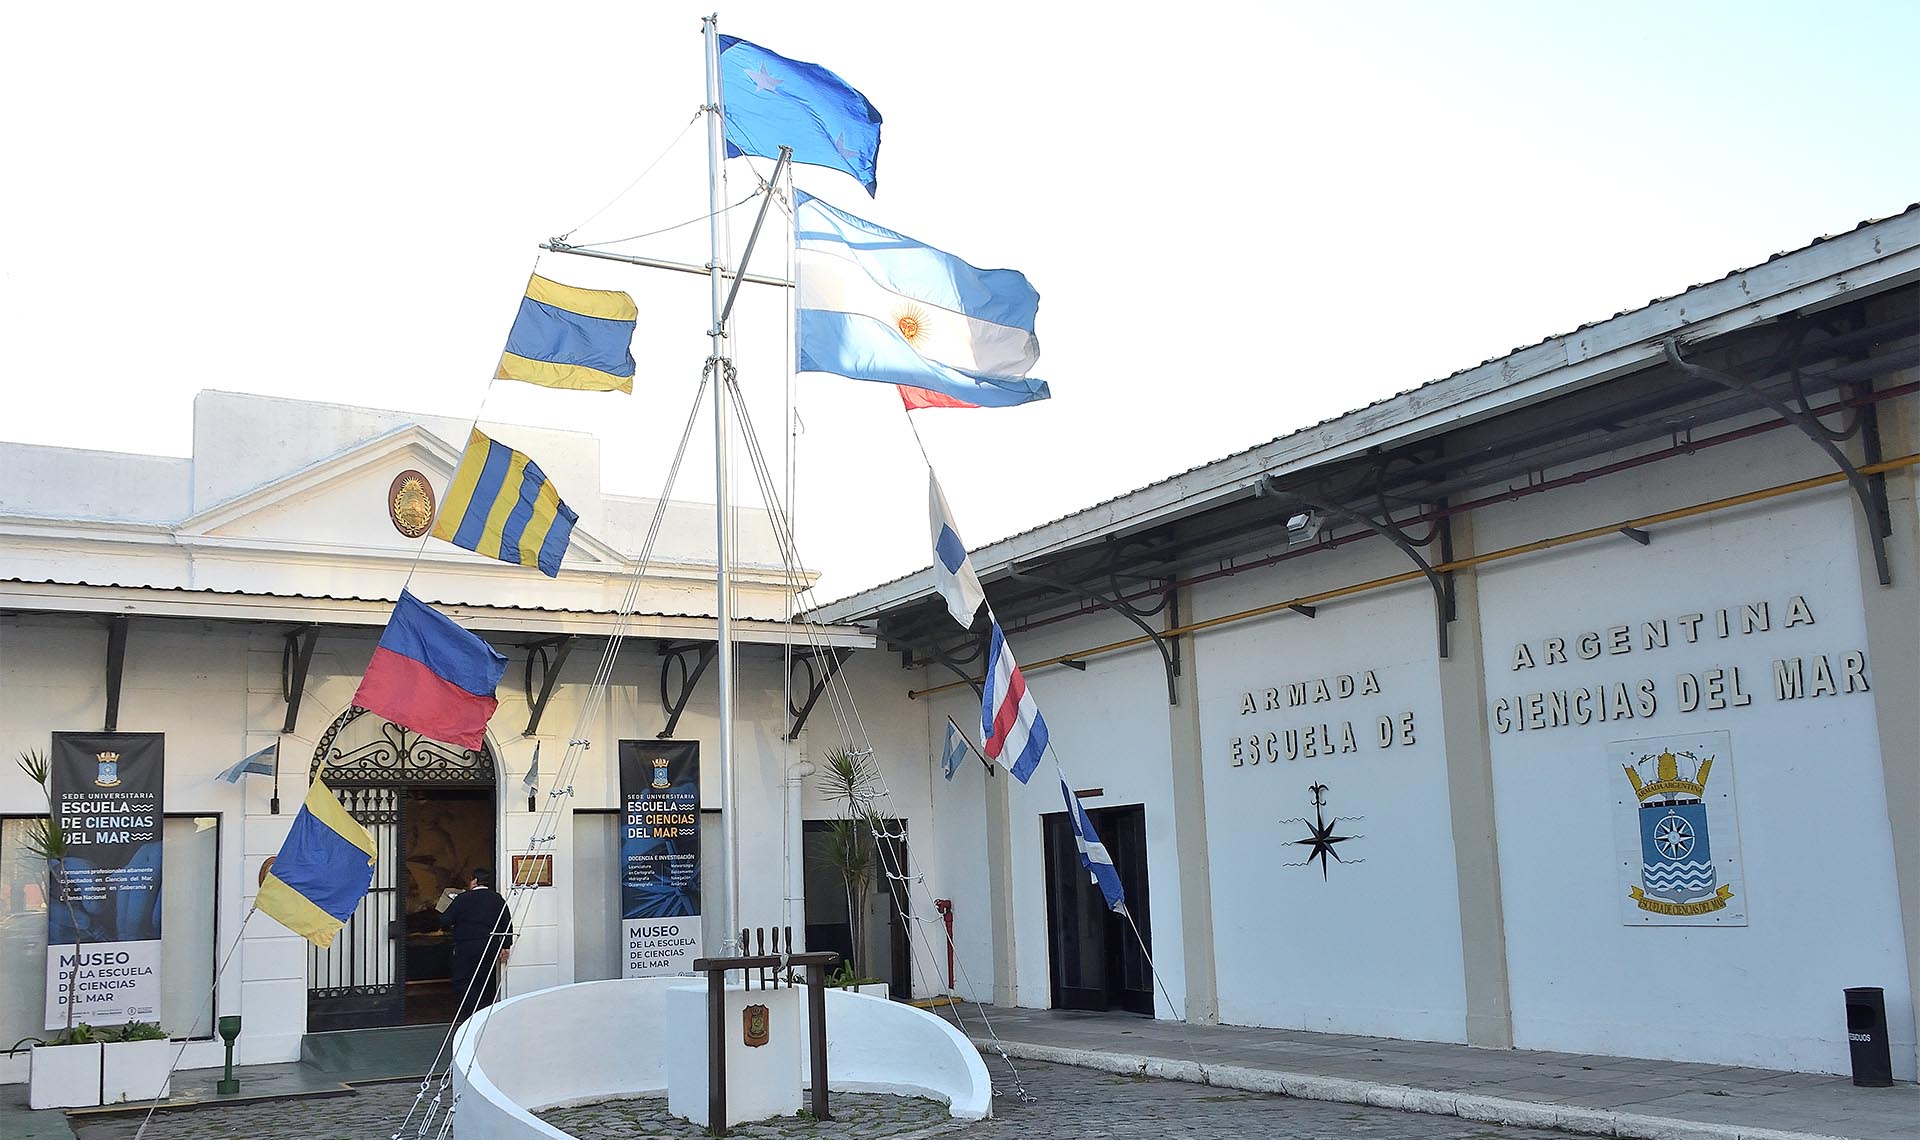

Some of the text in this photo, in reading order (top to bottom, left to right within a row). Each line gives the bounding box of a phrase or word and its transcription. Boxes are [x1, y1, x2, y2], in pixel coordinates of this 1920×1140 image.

[1240, 595, 1815, 715] ARMADA ARGENTINA
[1229, 650, 1871, 767] ESCUELA DE CIENCIAS DEL MAR
[61, 801, 130, 814] ESCUELA
[627, 801, 678, 812] ESCUELA
[61, 816, 154, 829] DE CIENCIAS
[627, 813, 695, 825] DE CIENCIAS
[96, 831, 130, 844] MAR
[628, 827, 678, 839] DEL MAR
[630, 925, 680, 938] MUSEO
[630, 937, 697, 949] DE LA ESCUELA
[60, 951, 130, 968] MUSEO
[630, 948, 685, 959] DE CIENCIAS
[630, 959, 670, 969] DEL MAR
[79, 970, 95, 979] LA
[98, 966, 153, 978] ESCUELA
[79, 979, 136, 991] CIENCIAS
[86, 993, 114, 1003] MAR
